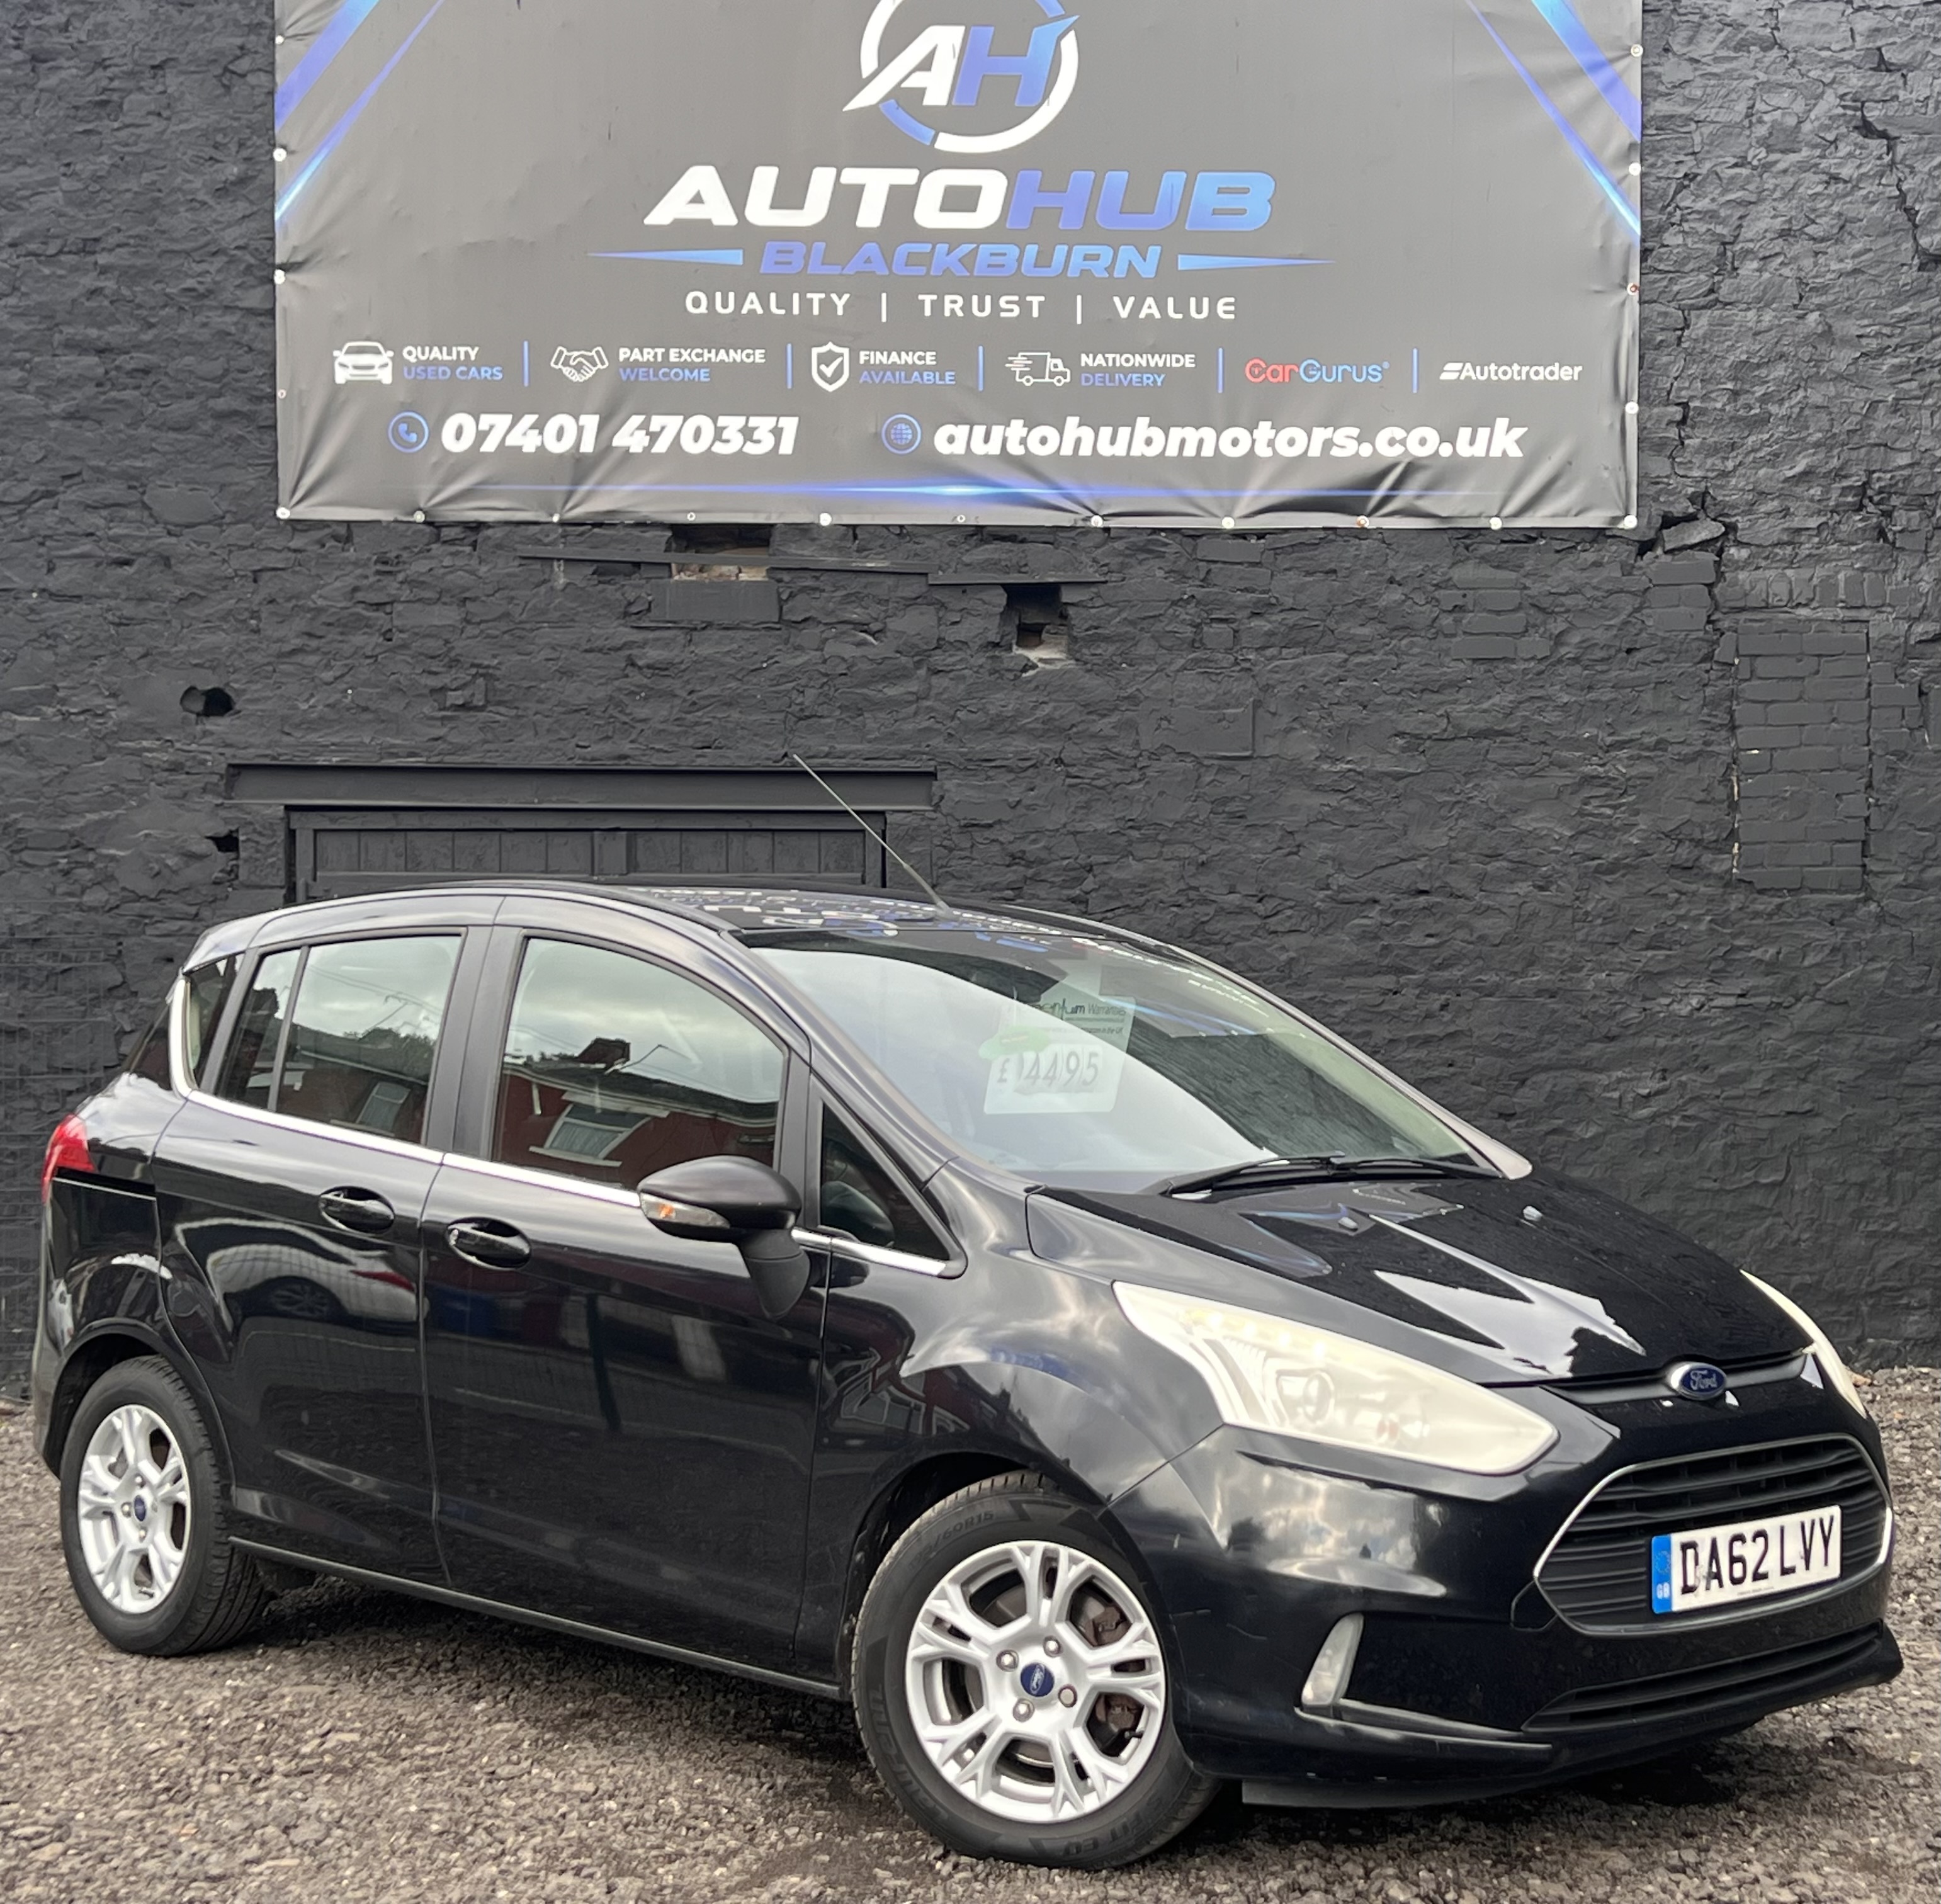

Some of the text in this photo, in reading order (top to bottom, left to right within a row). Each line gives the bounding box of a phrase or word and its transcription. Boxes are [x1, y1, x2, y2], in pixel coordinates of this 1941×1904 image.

[843, 16, 1080, 111] AH
[644, 165, 1276, 231] AUTOHUB
[760, 241, 1162, 278] BLACKBURN
[685, 290, 1236, 319] QUALITY TRUST VALUE
[403, 346, 478, 363] QUALITY
[619, 348, 766, 364] PART EXCHANGE
[859, 351, 937, 365] FINANCE
[1081, 353, 1196, 368] NATIONWIDE
[404, 366, 503, 380] USED CARS
[620, 368, 711, 382] WELCOME
[859, 371, 956, 385] AVAILABLE
[1082, 373, 1165, 387] DELIVERY
[1459, 362, 1583, 381] Autotrader
[441, 412, 799, 455] 07401 470331
[934, 416, 1529, 458] autohubmotors.co.uk
[1690, 1369, 1717, 1390] Ford
[1680, 1515, 1835, 1595] DA62 LVY
[1656, 1582, 1670, 1599] GB
